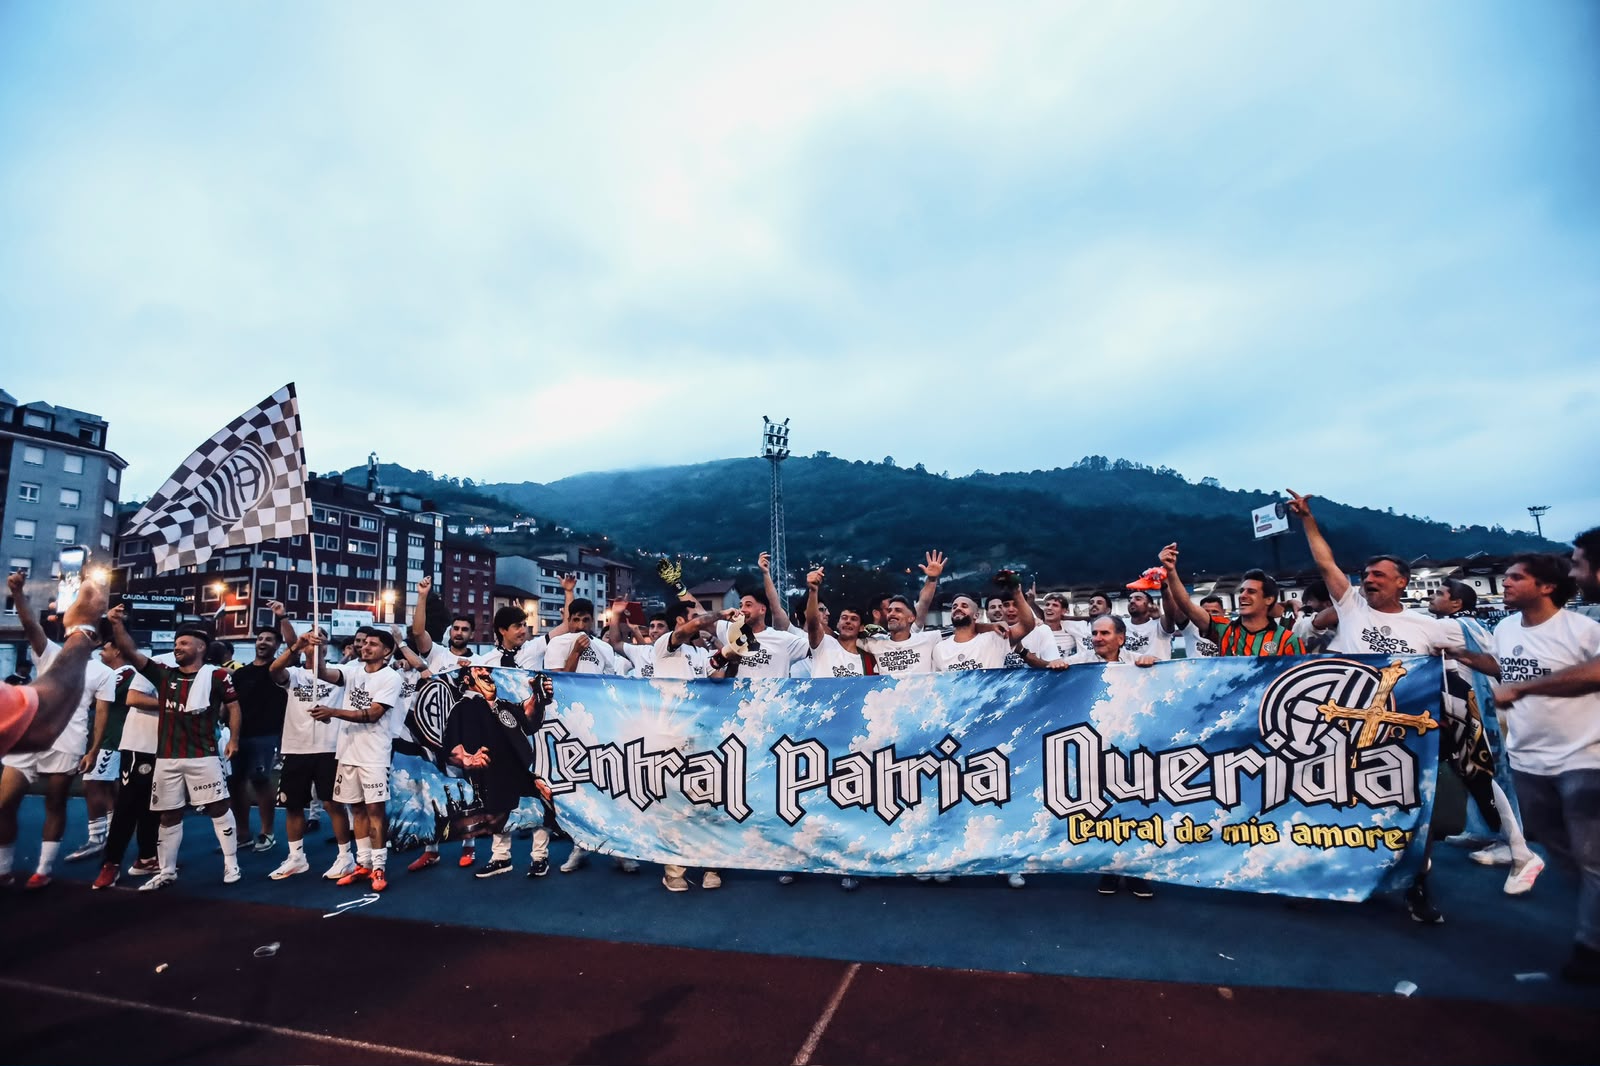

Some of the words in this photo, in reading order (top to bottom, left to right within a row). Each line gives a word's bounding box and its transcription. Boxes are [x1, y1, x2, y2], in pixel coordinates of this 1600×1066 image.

[879, 654, 908, 662] EQUIPO
[884, 649, 914, 657] SOMOS
[880, 657, 920, 668] SEGUNDA
[948, 659, 976, 670] SOMOS
[533, 719, 753, 824] Central
[770, 733, 1011, 826] Patria
[1042, 721, 1421, 820] Querida
[193, 781, 222, 791] GROSSO
[1068, 812, 1167, 848] Central
[1174, 815, 1213, 844] de
[1222, 816, 1280, 847] mis
